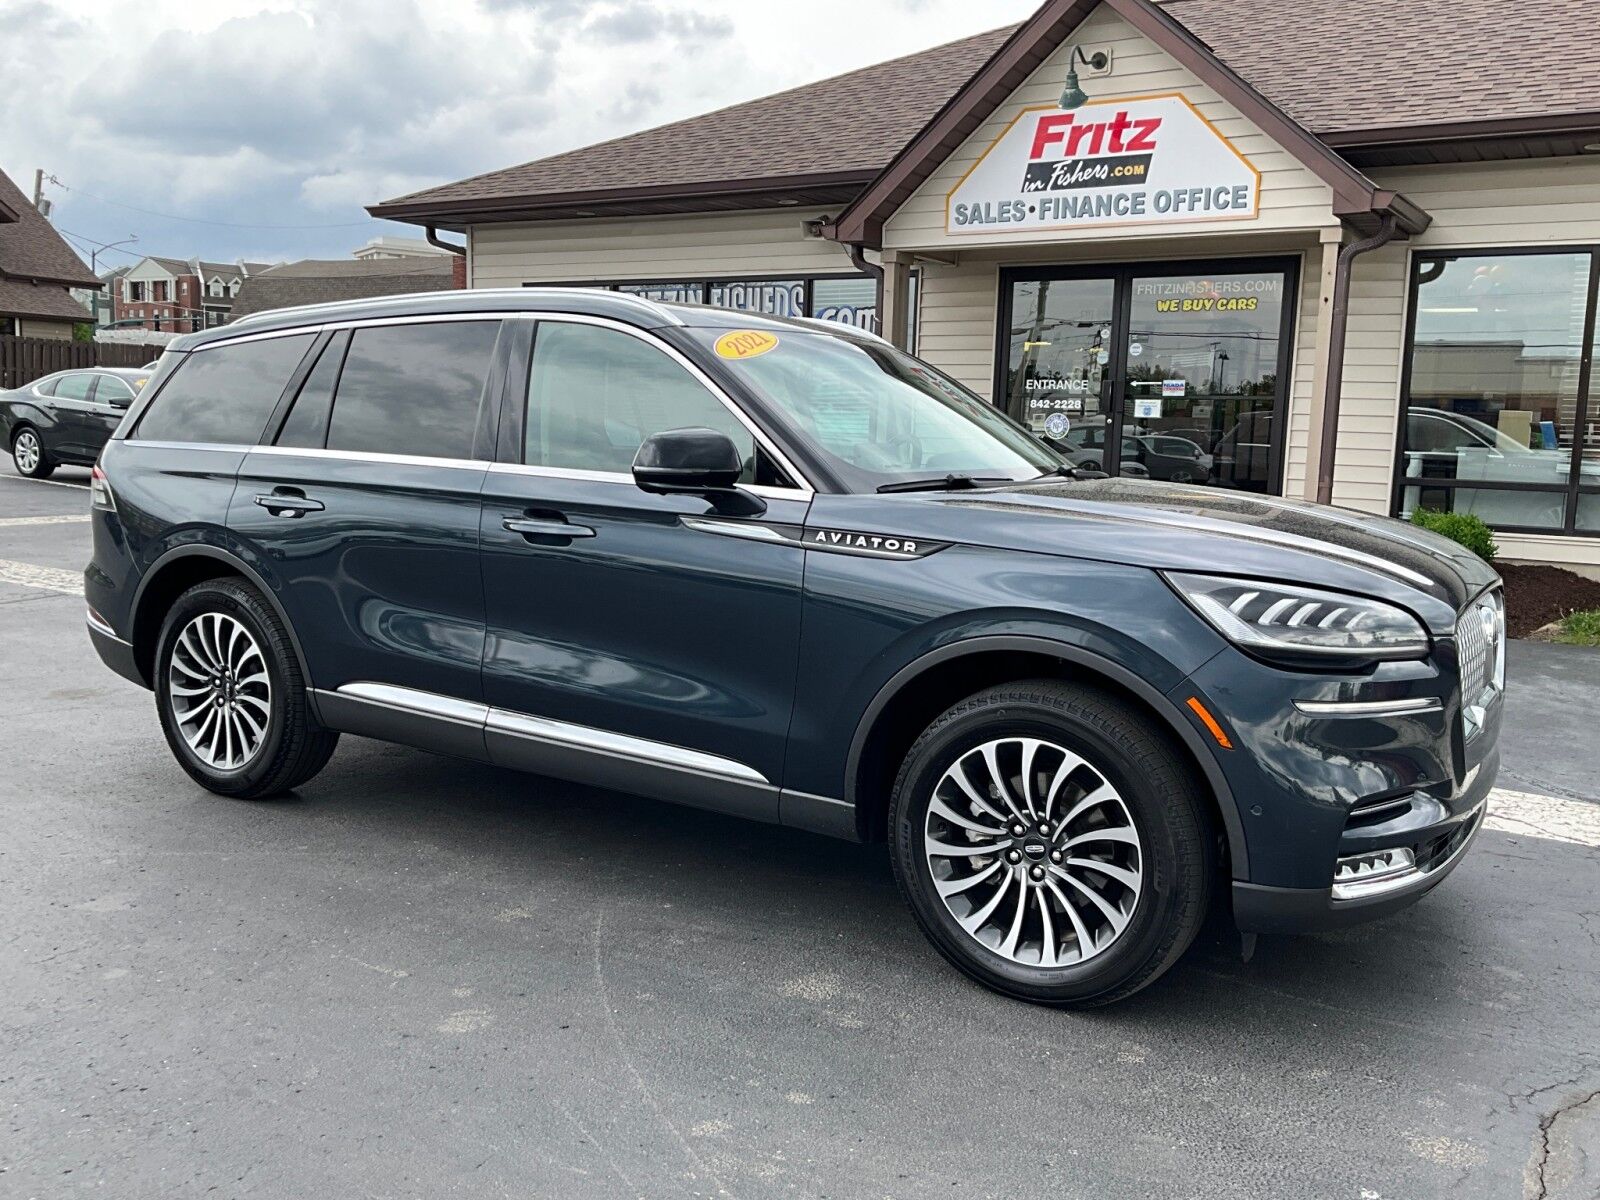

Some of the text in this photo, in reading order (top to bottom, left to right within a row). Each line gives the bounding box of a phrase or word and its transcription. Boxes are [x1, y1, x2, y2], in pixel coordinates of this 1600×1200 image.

[1029, 111, 1162, 160] Fritz
[1025, 174, 1045, 192] in
[1154, 185, 1248, 213] OFFICE
[1137, 280, 1277, 295] FRITZINFISHERS.COM
[1157, 296, 1258, 312] WE BUY CARS
[725, 331, 772, 356] 2021
[1026, 379, 1089, 390] ENTRANCE
[1030, 399, 1082, 409] 842-2228
[816, 531, 916, 552] AVIATOR
